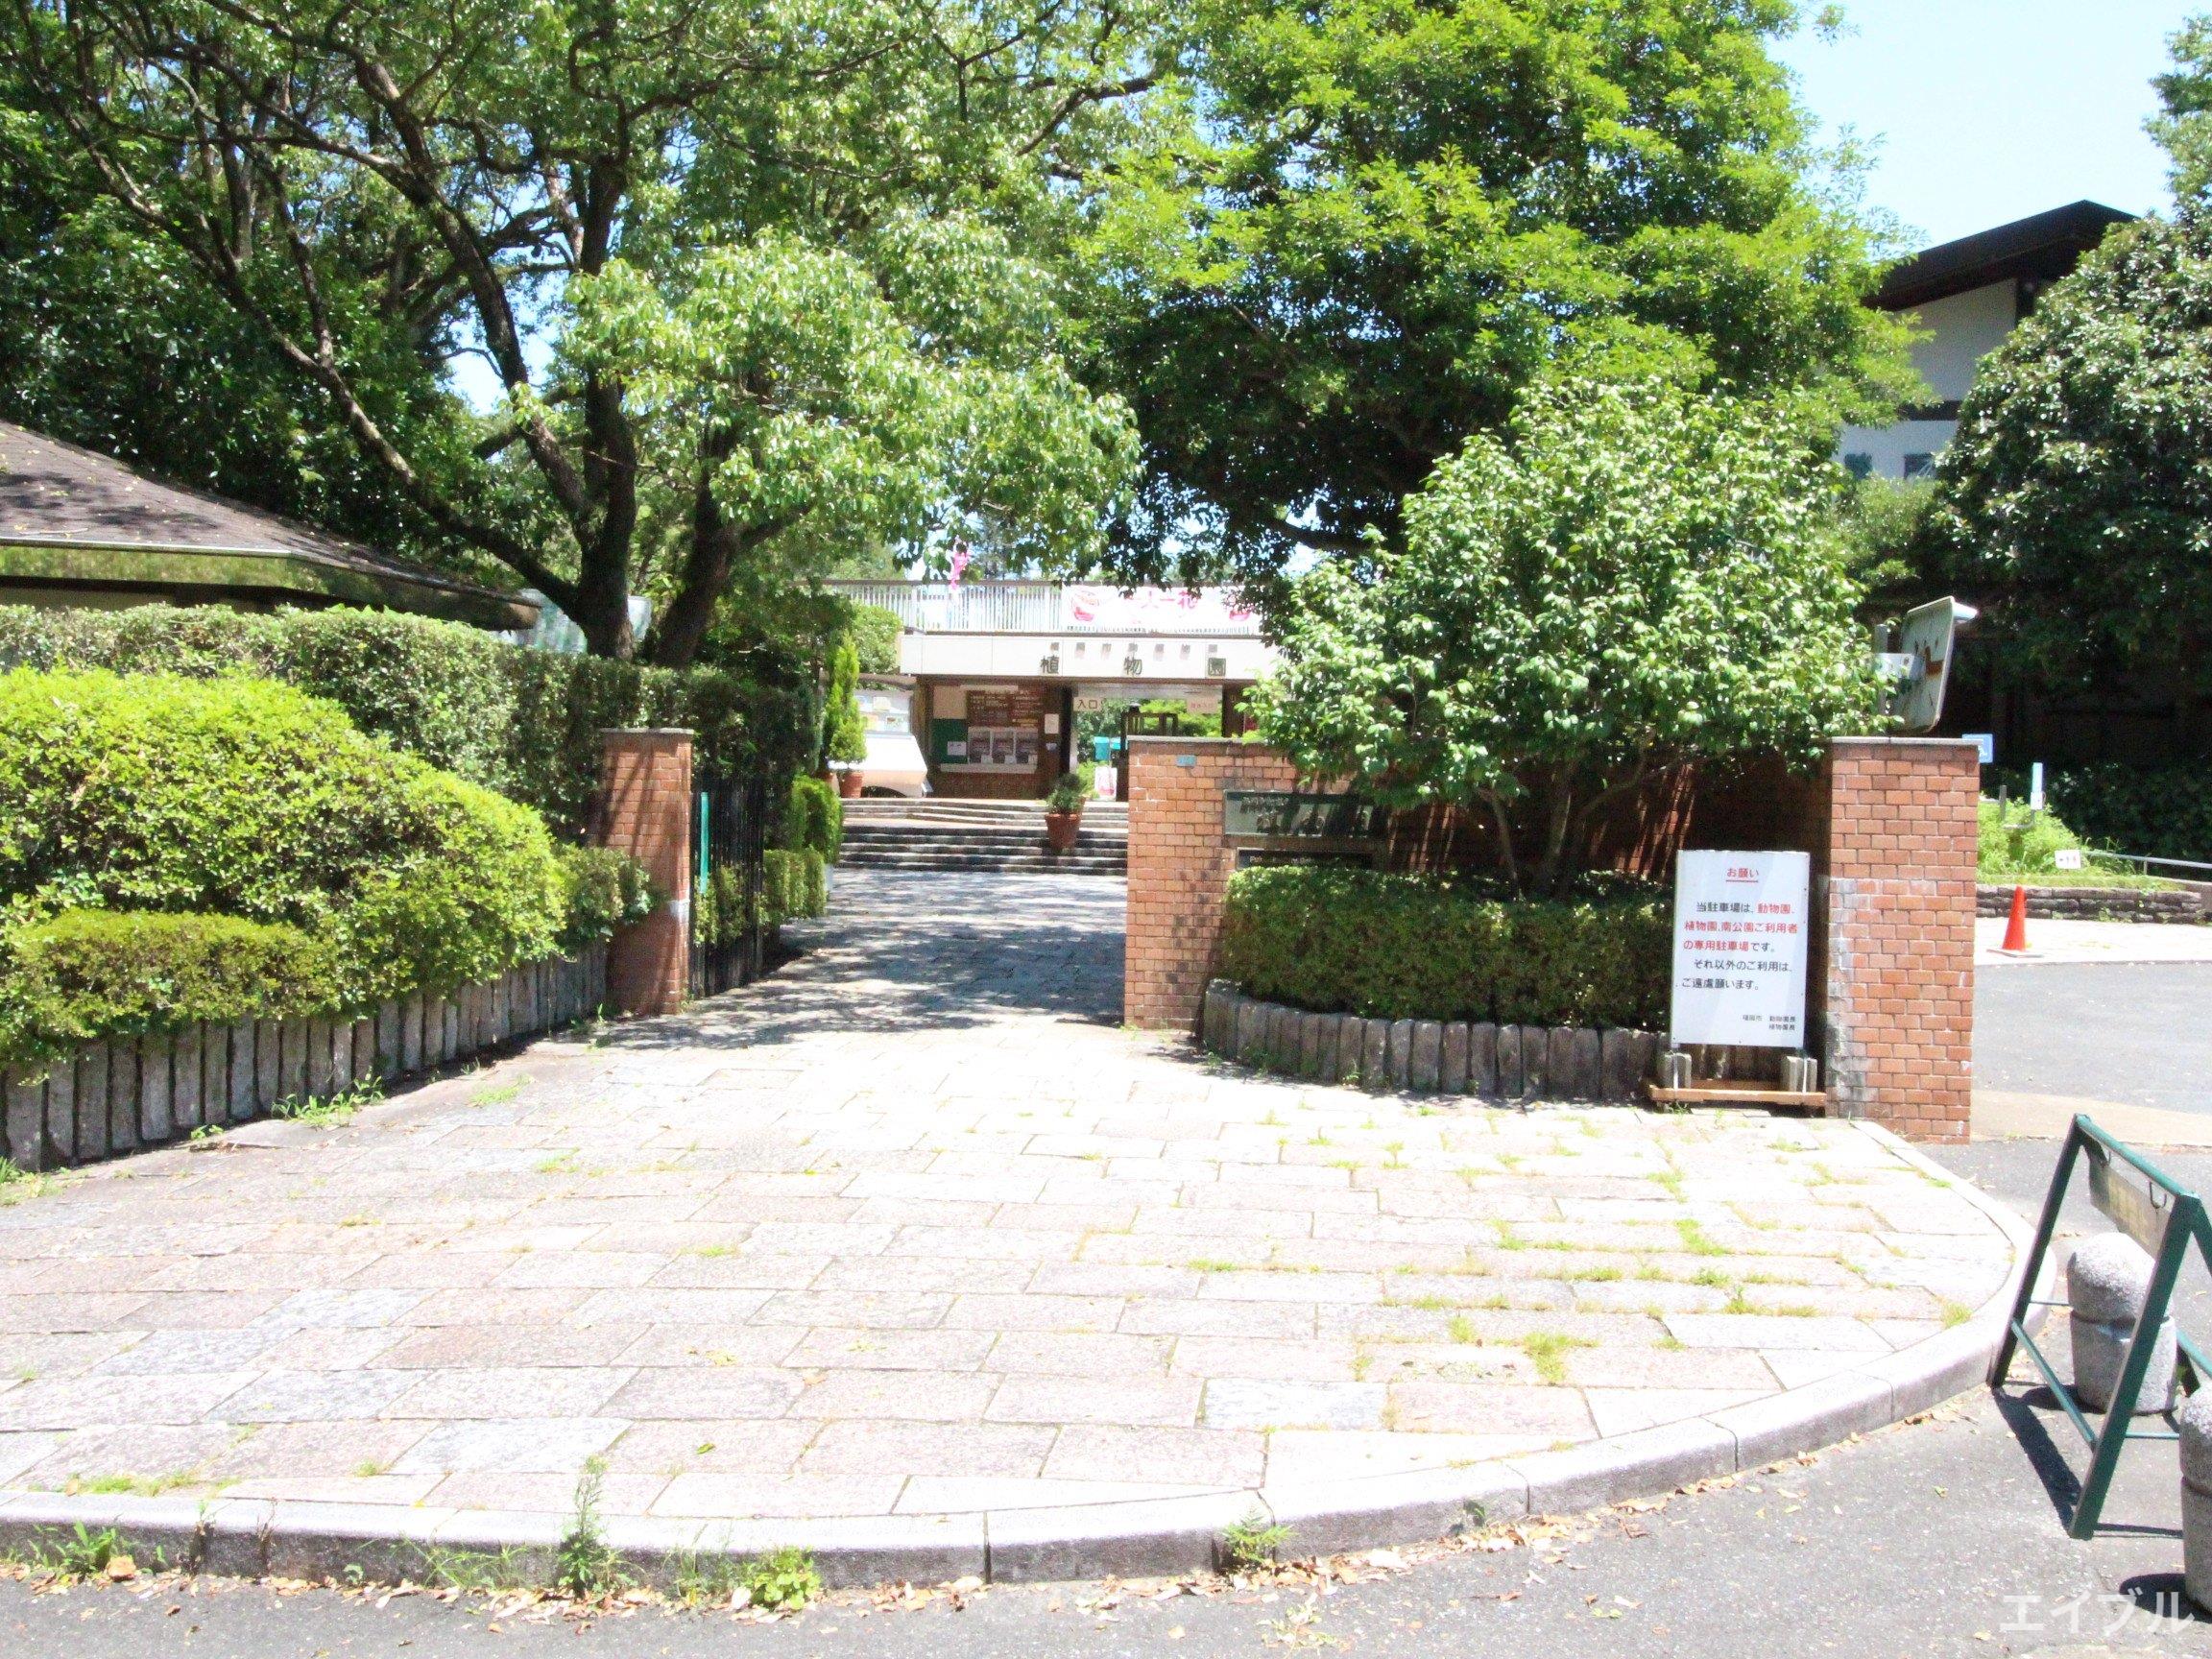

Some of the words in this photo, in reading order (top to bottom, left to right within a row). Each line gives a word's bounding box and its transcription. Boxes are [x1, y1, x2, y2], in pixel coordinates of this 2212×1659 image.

[1040, 655, 1227, 676] 植物園
[1077, 699, 1098, 709] 入口
[1726, 868, 1759, 878] お願い
